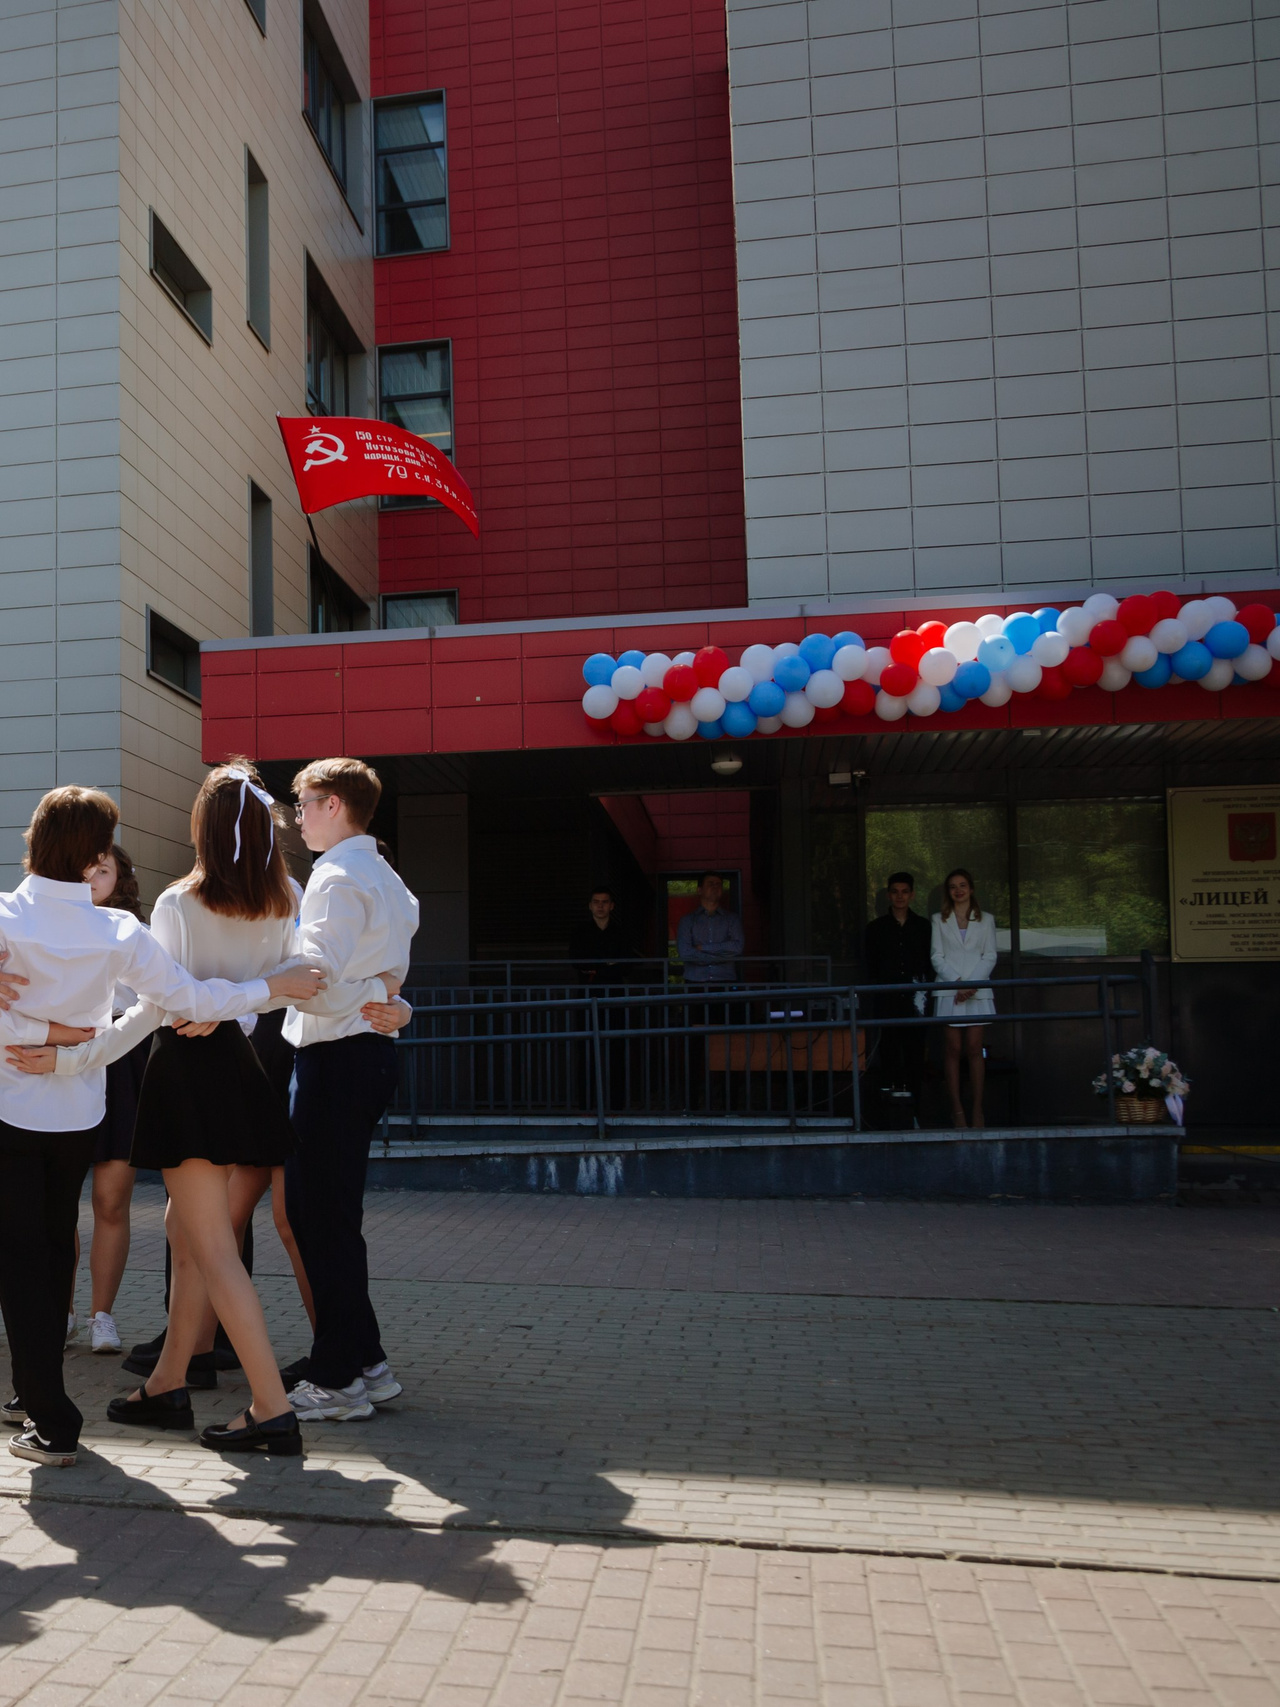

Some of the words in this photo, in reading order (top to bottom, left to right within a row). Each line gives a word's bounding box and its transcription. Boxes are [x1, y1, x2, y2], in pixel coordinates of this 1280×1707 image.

[355, 430, 372, 441] 150
[384, 463, 408, 479] 79
[1179, 887, 1269, 907] «ЛИЦЕЙ
